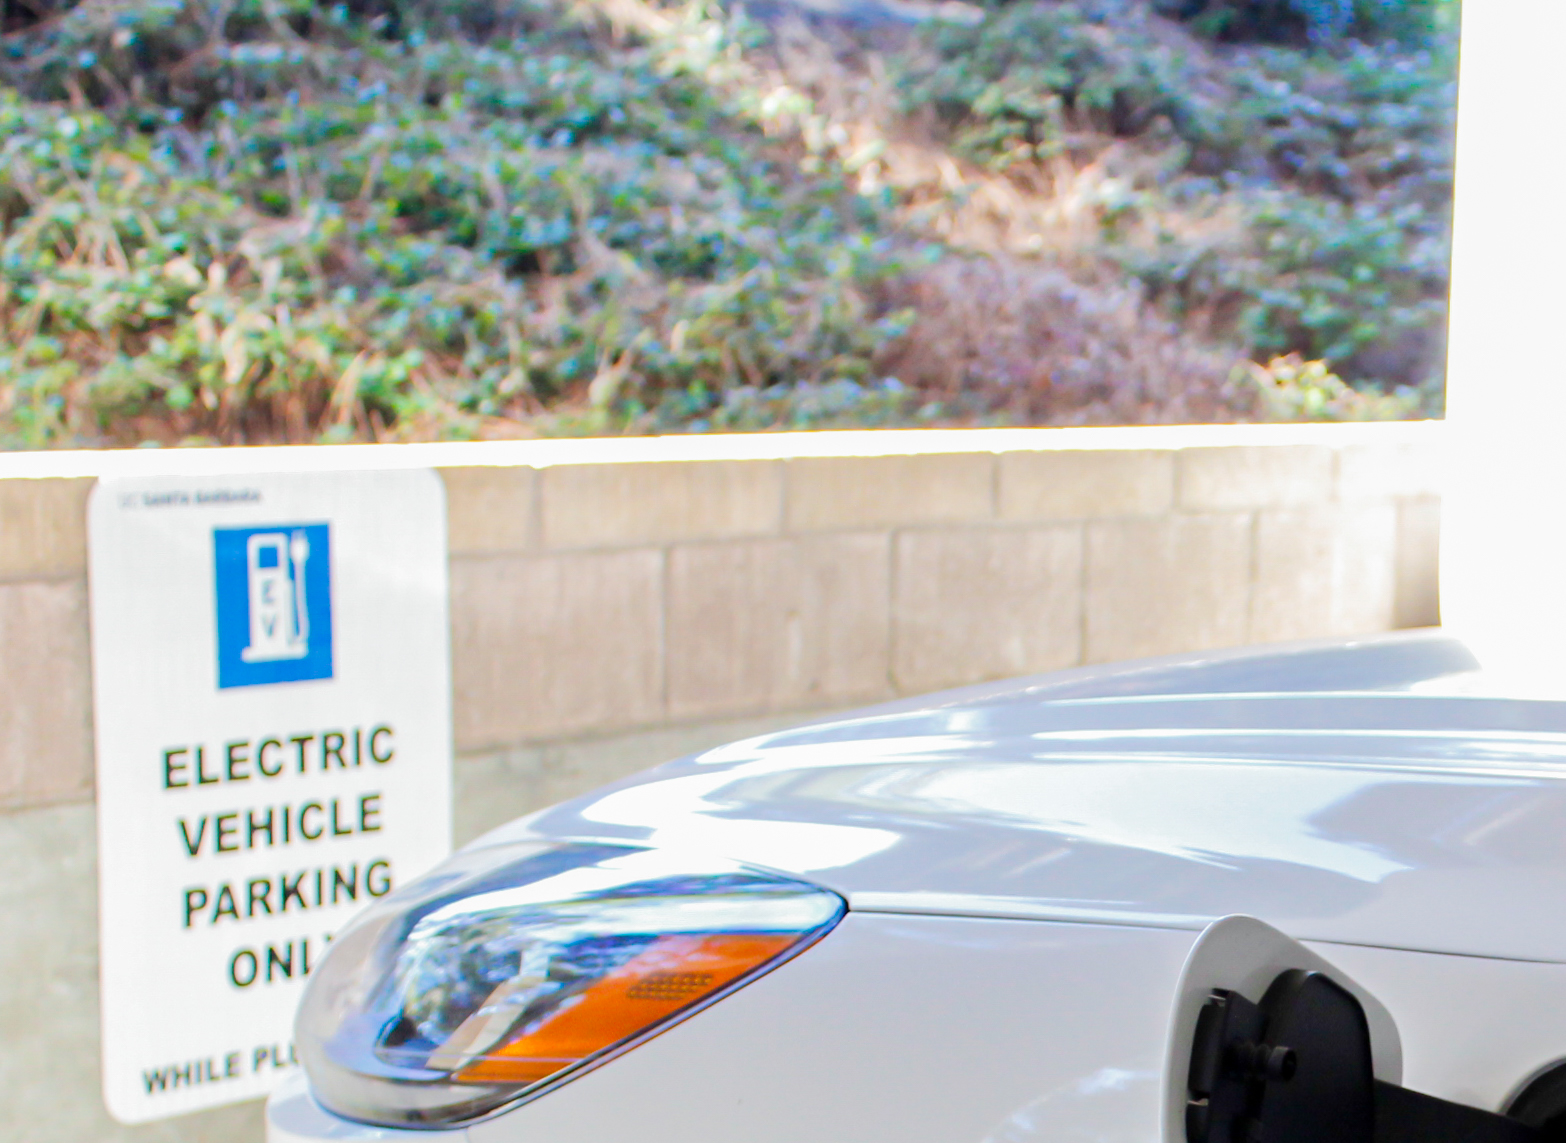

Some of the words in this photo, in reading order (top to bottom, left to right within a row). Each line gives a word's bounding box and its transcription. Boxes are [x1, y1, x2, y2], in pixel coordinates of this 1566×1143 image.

[162, 726, 394, 790] ELECTRIC
[178, 795, 383, 857] VEHICLE
[183, 860, 393, 928] PARKING
[230, 934, 333, 987] ONL
[143, 1052, 244, 1095] WHILE
